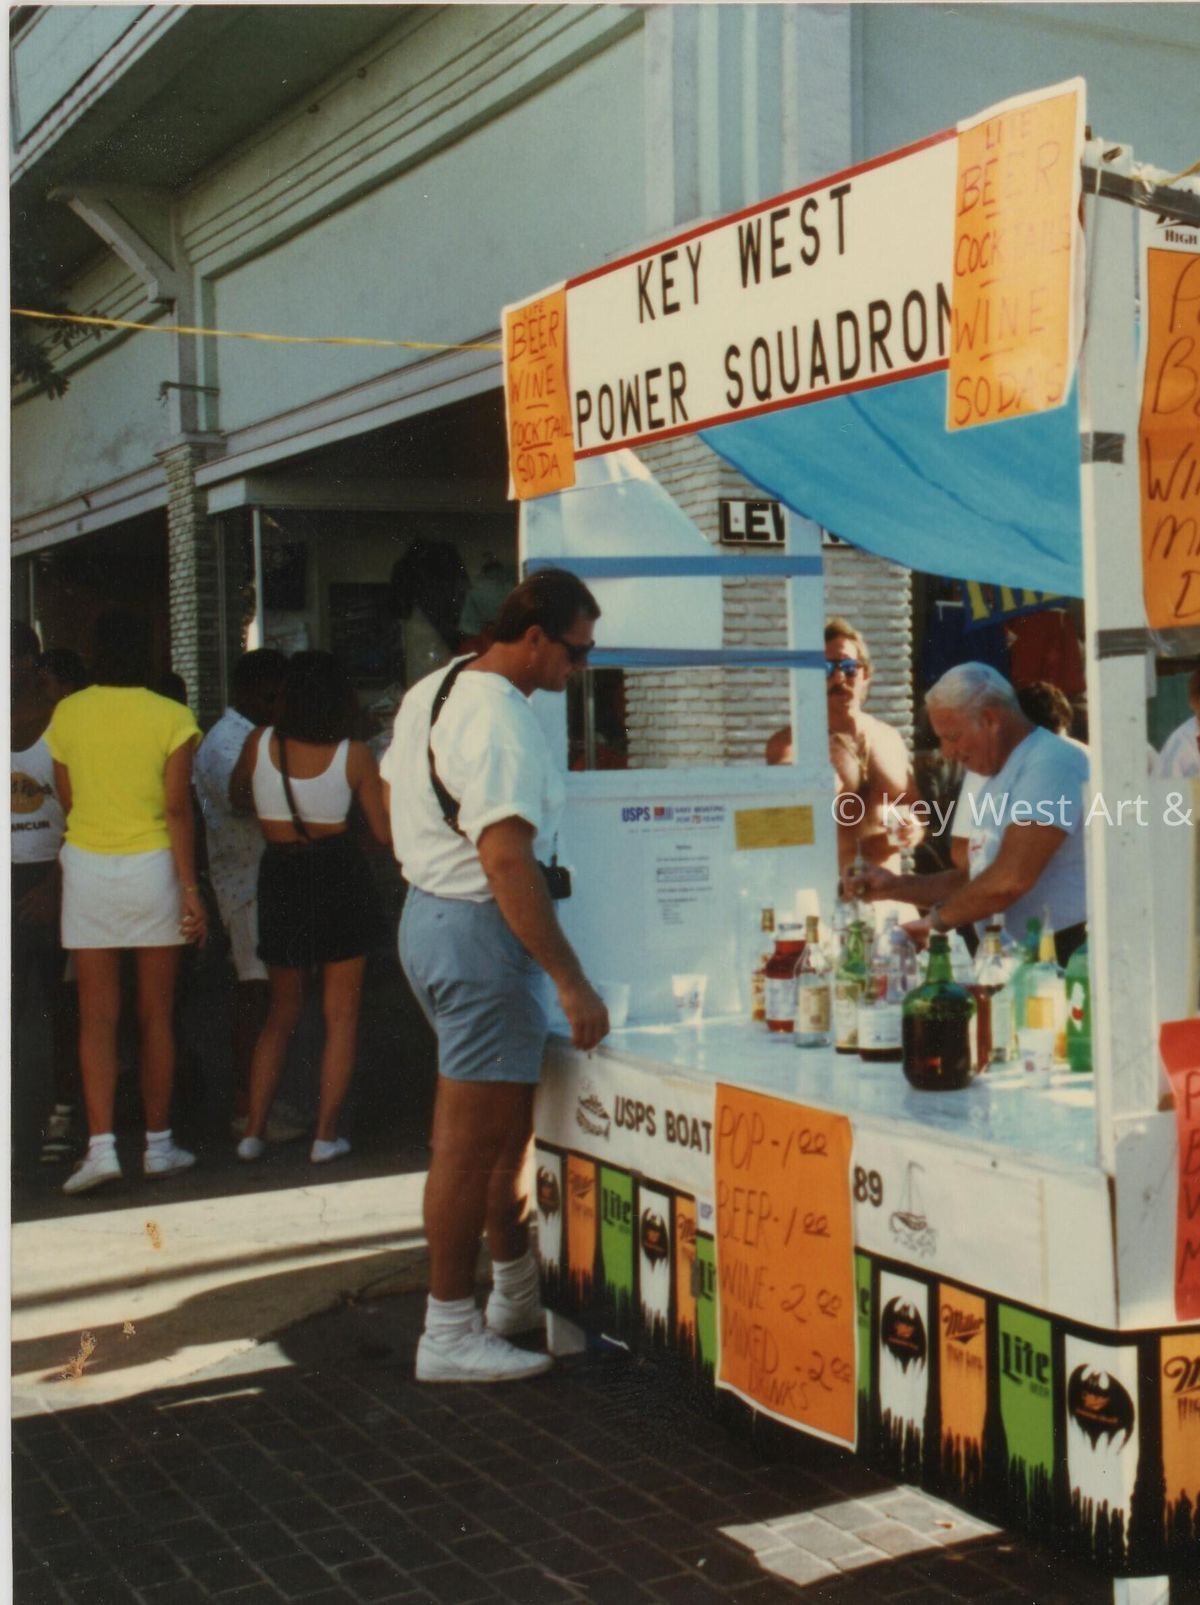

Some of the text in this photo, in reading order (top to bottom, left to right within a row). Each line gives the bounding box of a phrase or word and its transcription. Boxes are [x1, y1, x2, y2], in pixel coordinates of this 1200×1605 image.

[958, 141, 1061, 217] BEER
[637, 183, 851, 324] KEY WEST
[510, 310, 559, 363] BEER
[955, 286, 1047, 353] WINE
[510, 363, 556, 404] WINE
[575, 281, 951, 447] POWER SQUADRON
[516, 452, 562, 483] SODA
[621, 806, 651, 822] USPS
[615, 1095, 656, 1137] USPS
[717, 1104, 764, 1170] POP
[717, 1180, 773, 1248] BEER
[721, 1259, 768, 1310] WINE
[1001, 1330, 1050, 1385] Lite
